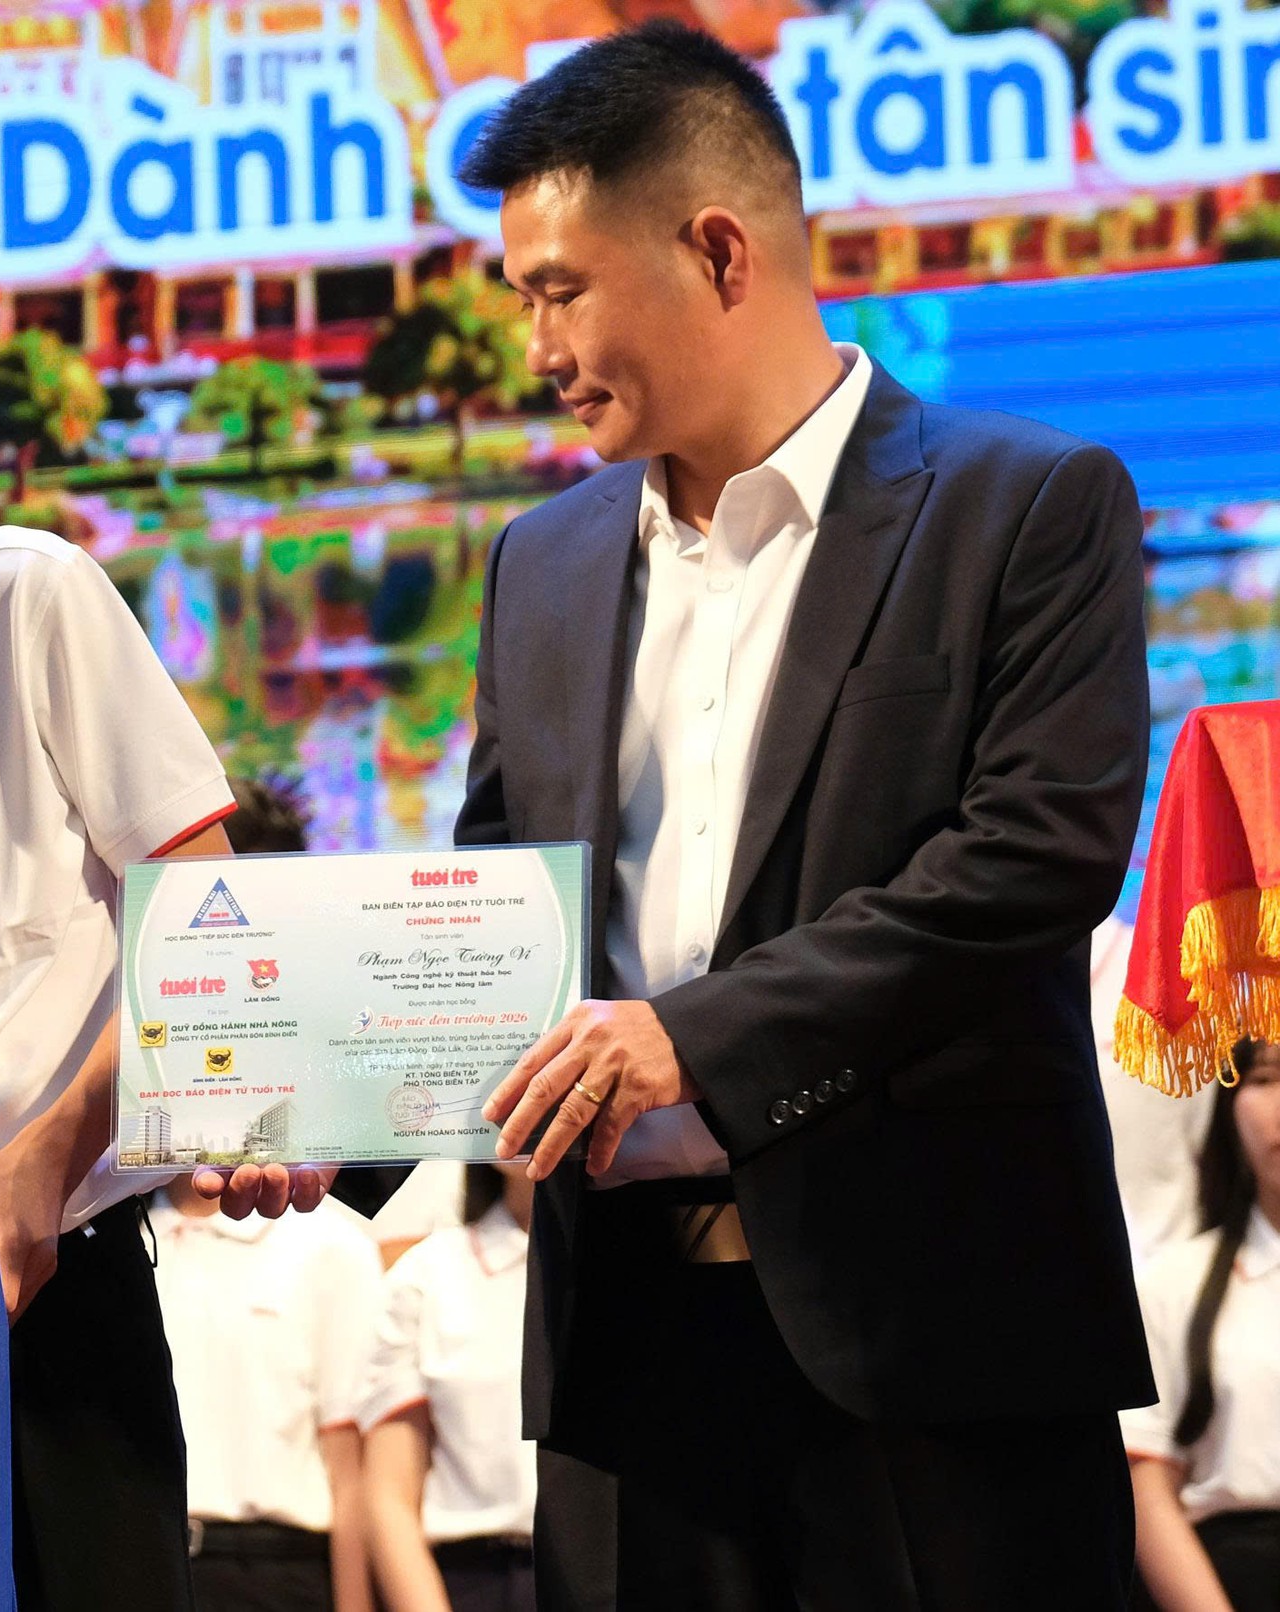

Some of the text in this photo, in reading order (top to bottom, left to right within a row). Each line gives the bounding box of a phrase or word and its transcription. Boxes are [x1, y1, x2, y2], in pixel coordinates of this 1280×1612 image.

[1, 94, 384, 251] Dành
[795, 28, 1049, 181] tân
[361, 903, 381, 911] BAN
[383, 901, 404, 910] BIÊN
[406, 901, 424, 910] TẬP
[425, 900, 445, 909] BÁO
[446, 899, 468, 908] ĐIỆN
[406, 914, 481, 926] CHỨNG NHẬN
[358, 950, 403, 968] Phạm
[408, 948, 449, 970] Ngọc
[373, 973, 398, 982] Ngành
[400, 972, 420, 980] Công
[423, 971, 442, 980] nghệ
[457, 970, 478, 978] thuật
[498, 969, 512, 977] học
[455, 981, 475, 989] Nông
[408, 1000, 426, 1008] Được
[406, 1015, 426, 1026] sức
[429, 1014, 450, 1025] đến
[499, 1012, 528, 1023] 2026
[192, 1022, 218, 1031] ĐỒNG
[221, 1021, 247, 1030] HÀNH
[249, 1020, 269, 1029] NHÀ
[271, 1019, 298, 1028] NÔNG
[328, 1038, 348, 1046] Dành
[465, 1044, 479, 1052] Gia
[445, 1061, 453, 1069] 17
[476, 1060, 485, 1068] 10
[443, 1069, 461, 1078] BIÊN
[445, 1078, 463, 1086] BIÊN
[185, 1087, 205, 1097] BÁO
[209, 1086, 231, 1097] ĐIỆN
[427, 1127, 456, 1137] HOÀNG
